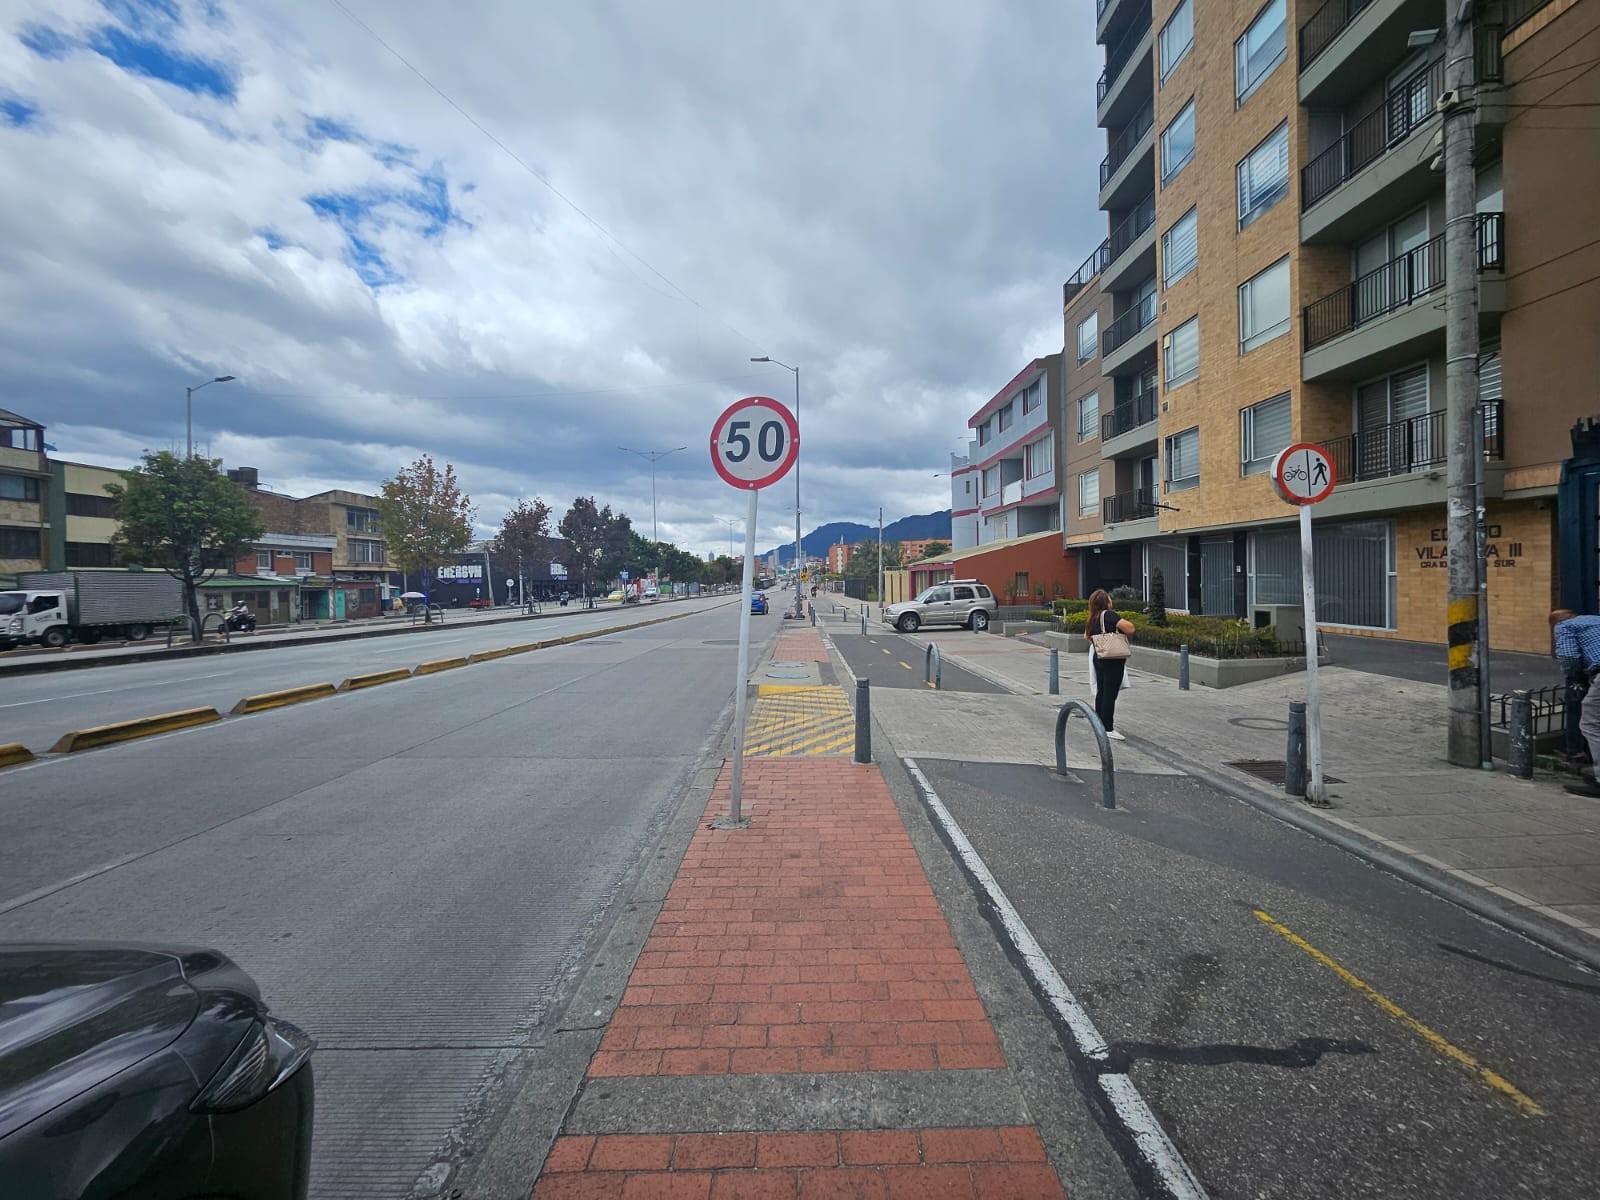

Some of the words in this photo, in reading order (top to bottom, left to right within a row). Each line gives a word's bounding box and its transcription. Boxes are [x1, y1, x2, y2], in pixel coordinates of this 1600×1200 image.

[725, 420, 785, 463] 50
[1509, 543, 1523, 557] III
[1420, 561, 1437, 569] CRA
[1494, 559, 1516, 568] SUR
